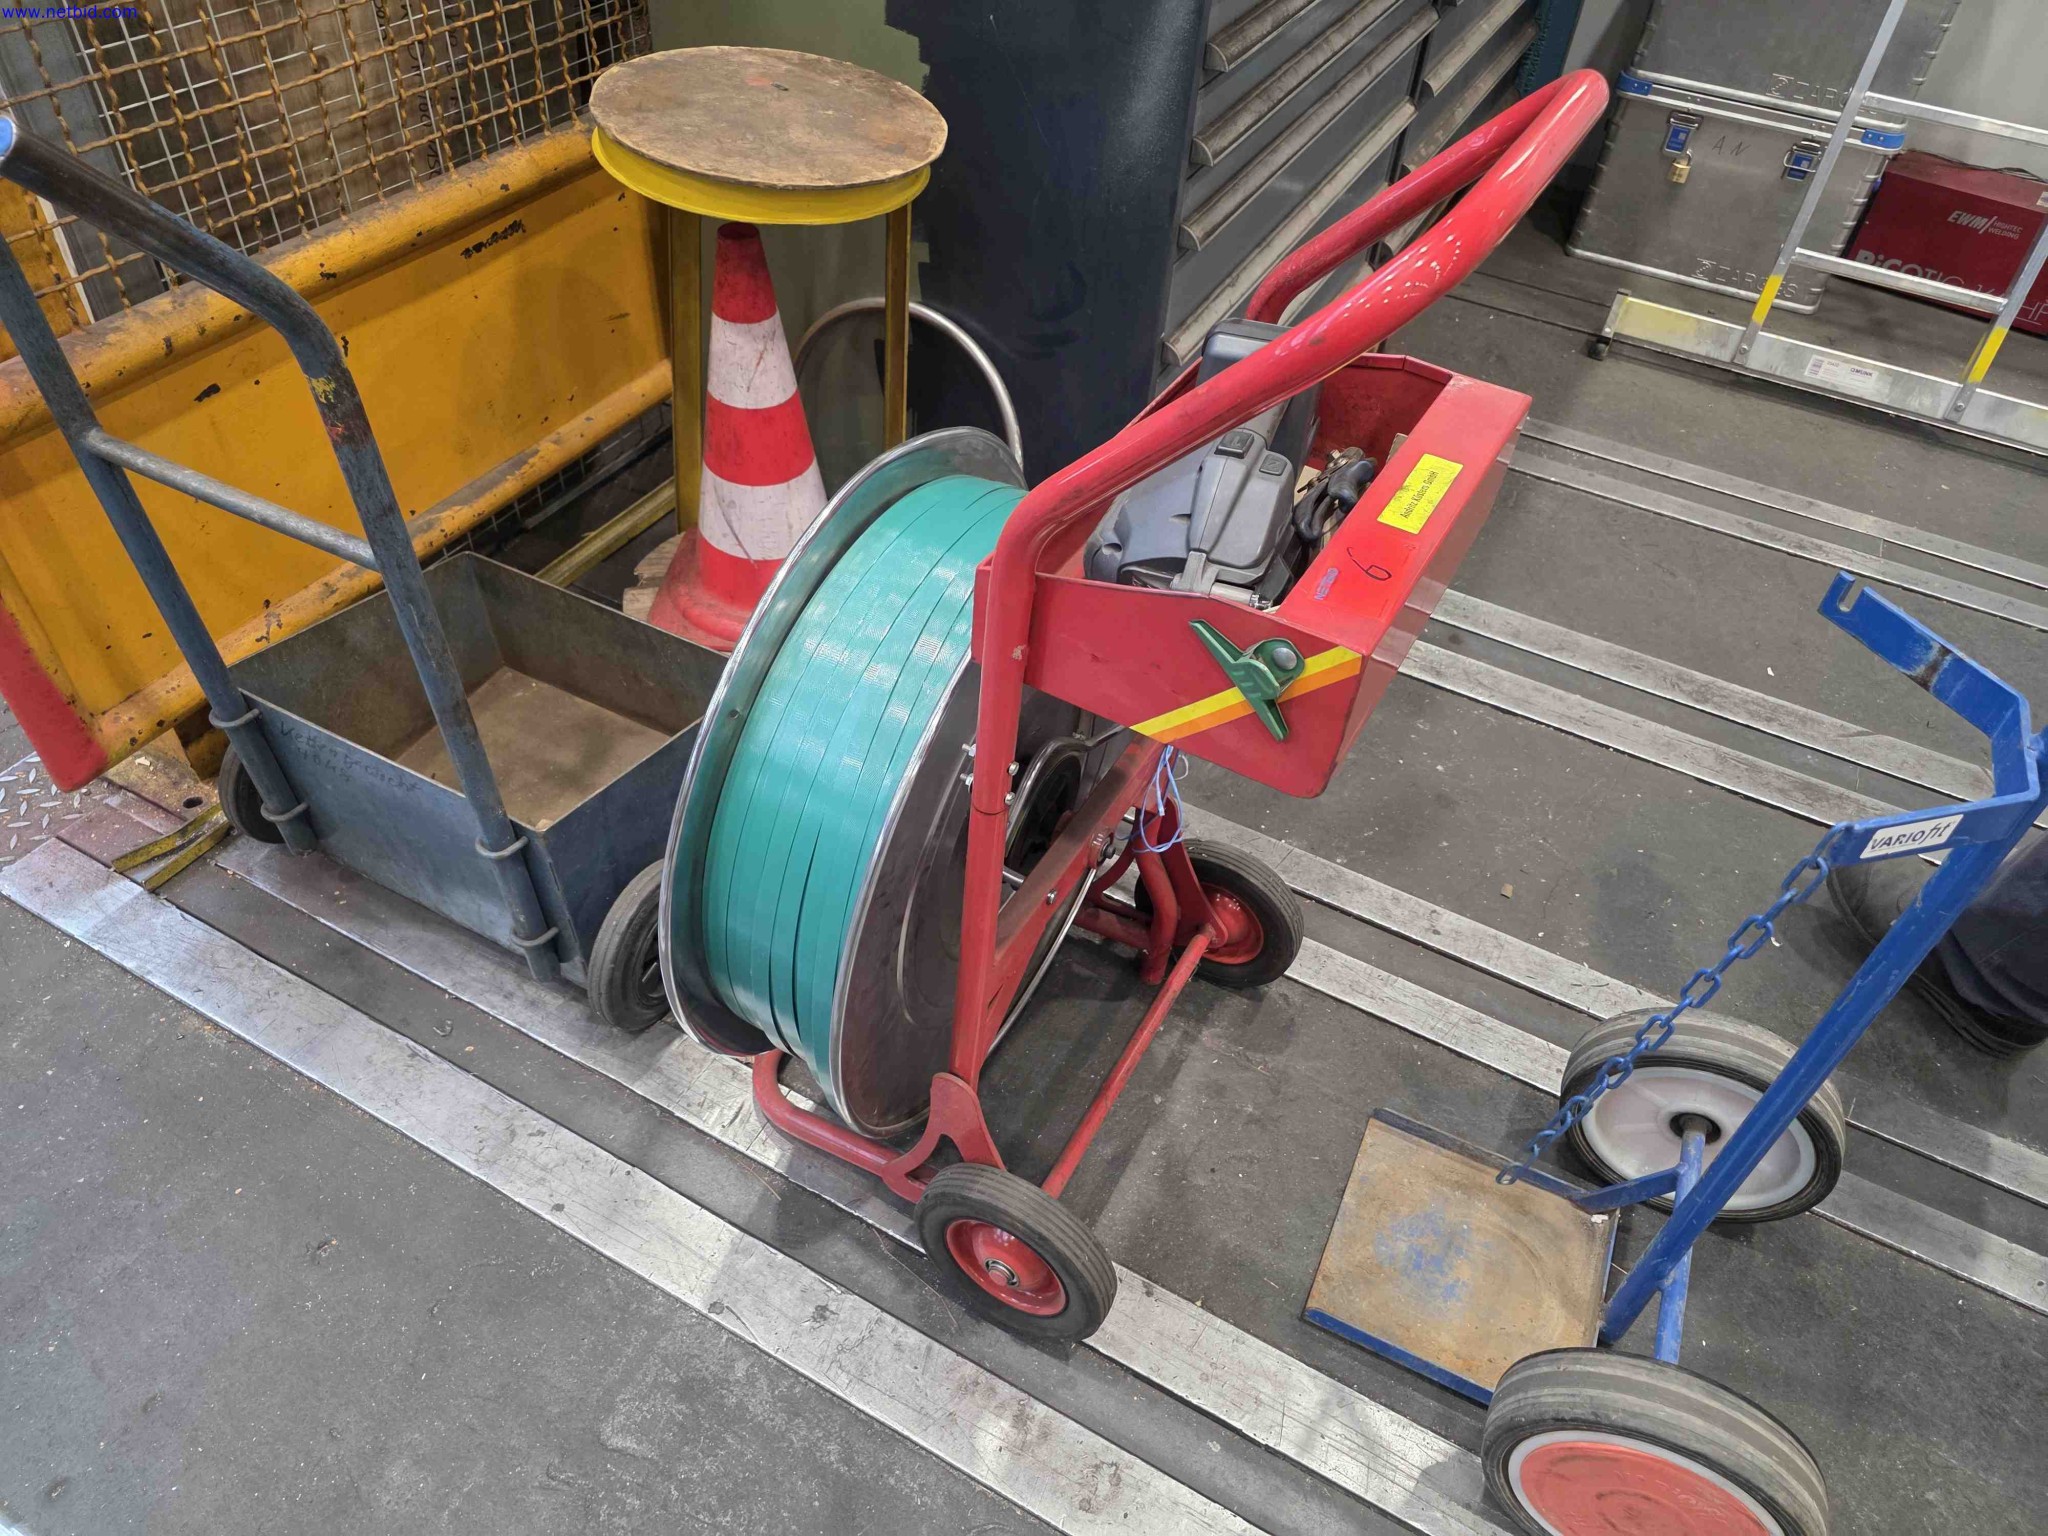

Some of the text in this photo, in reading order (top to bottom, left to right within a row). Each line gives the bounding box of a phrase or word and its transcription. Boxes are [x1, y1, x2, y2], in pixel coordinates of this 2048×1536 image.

[1947, 211, 1989, 230] EWM
[1987, 227, 2021, 240] WELDING
[1423, 470, 1439, 485] GmbH
